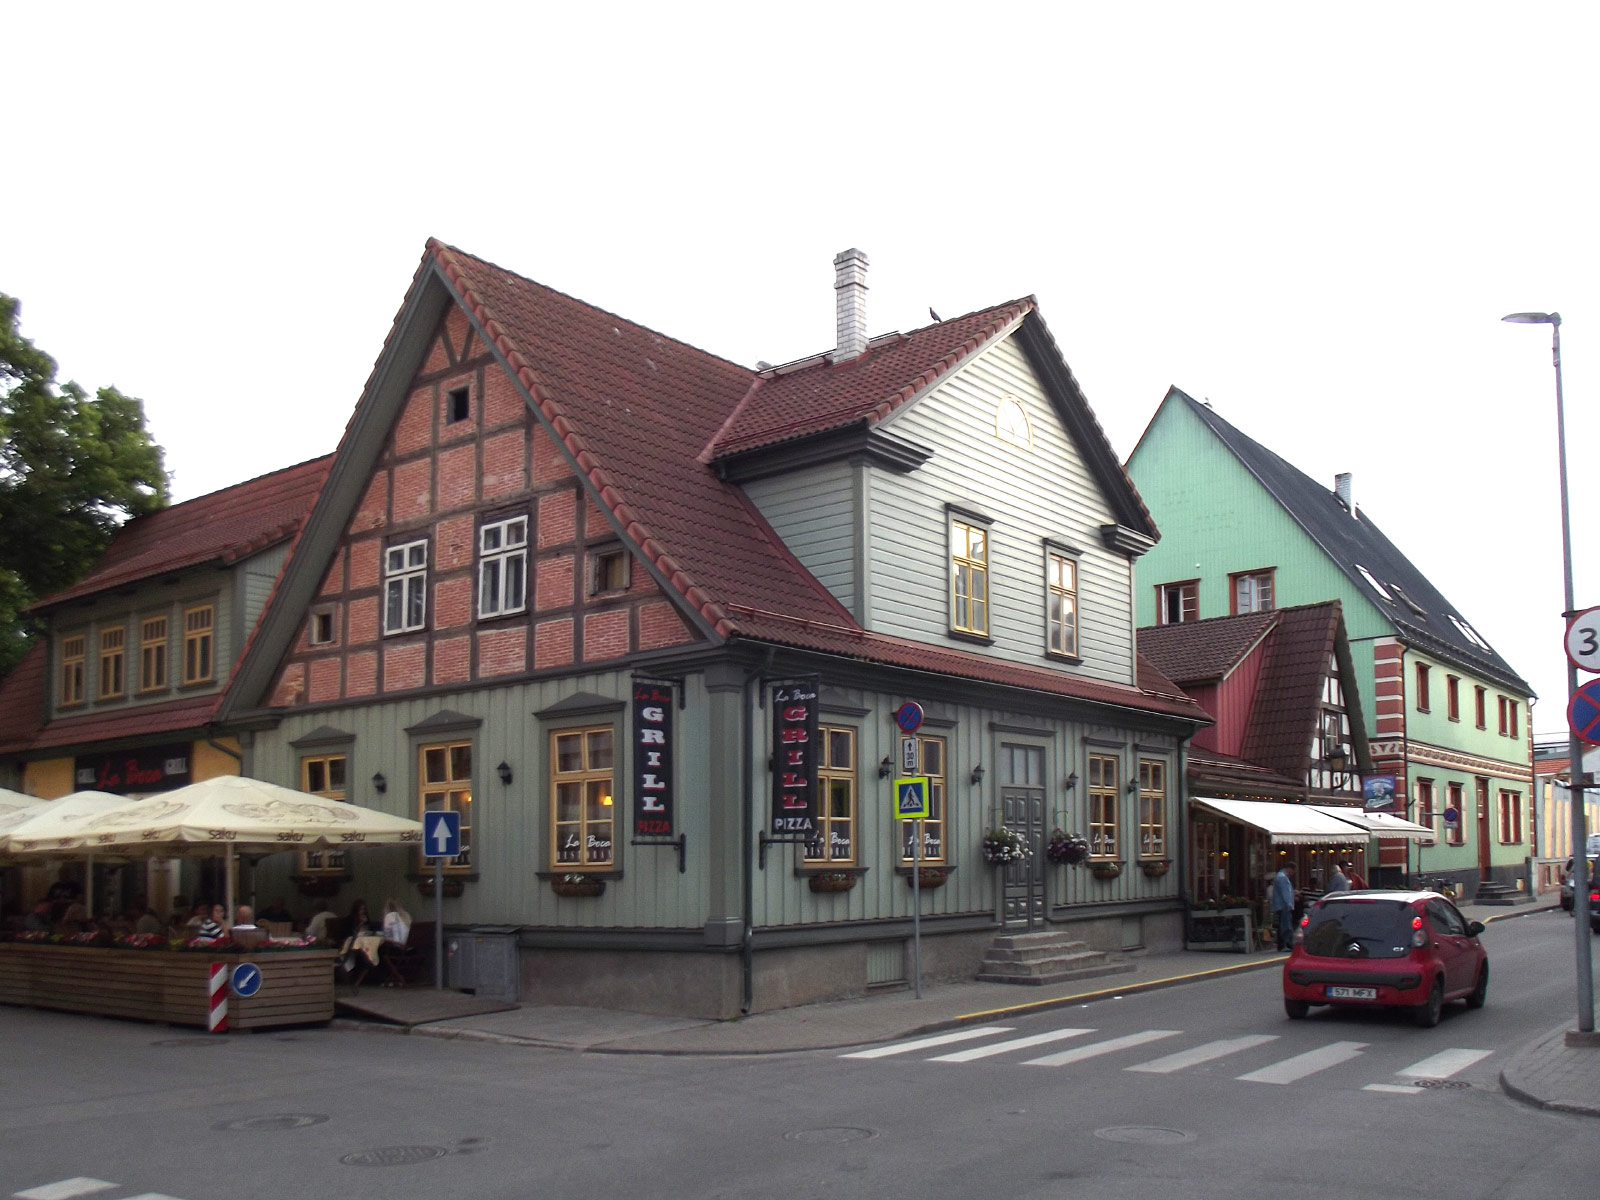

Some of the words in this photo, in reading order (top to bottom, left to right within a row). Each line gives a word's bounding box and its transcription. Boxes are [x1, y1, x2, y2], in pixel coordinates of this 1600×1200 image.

[775, 689, 789, 702] La
[793, 689, 816, 701] Boca
[641, 706, 666, 813] GRILL
[782, 706, 808, 809] GRILL
[906, 752, 914, 760] 30
[637, 821, 670, 833] PIZZA
[774, 818, 812, 830] PIZZA
[209, 828, 237, 840] saku
[277, 829, 304, 841] saku
[341, 830, 367, 842] saku
[830, 831, 850, 845] Boca
[924, 832, 941, 845] Boca
[565, 834, 580, 848] La
[586, 834, 611, 848] Boca
[1334, 987, 1350, 997] 571
[1353, 989, 1374, 998] MFX
